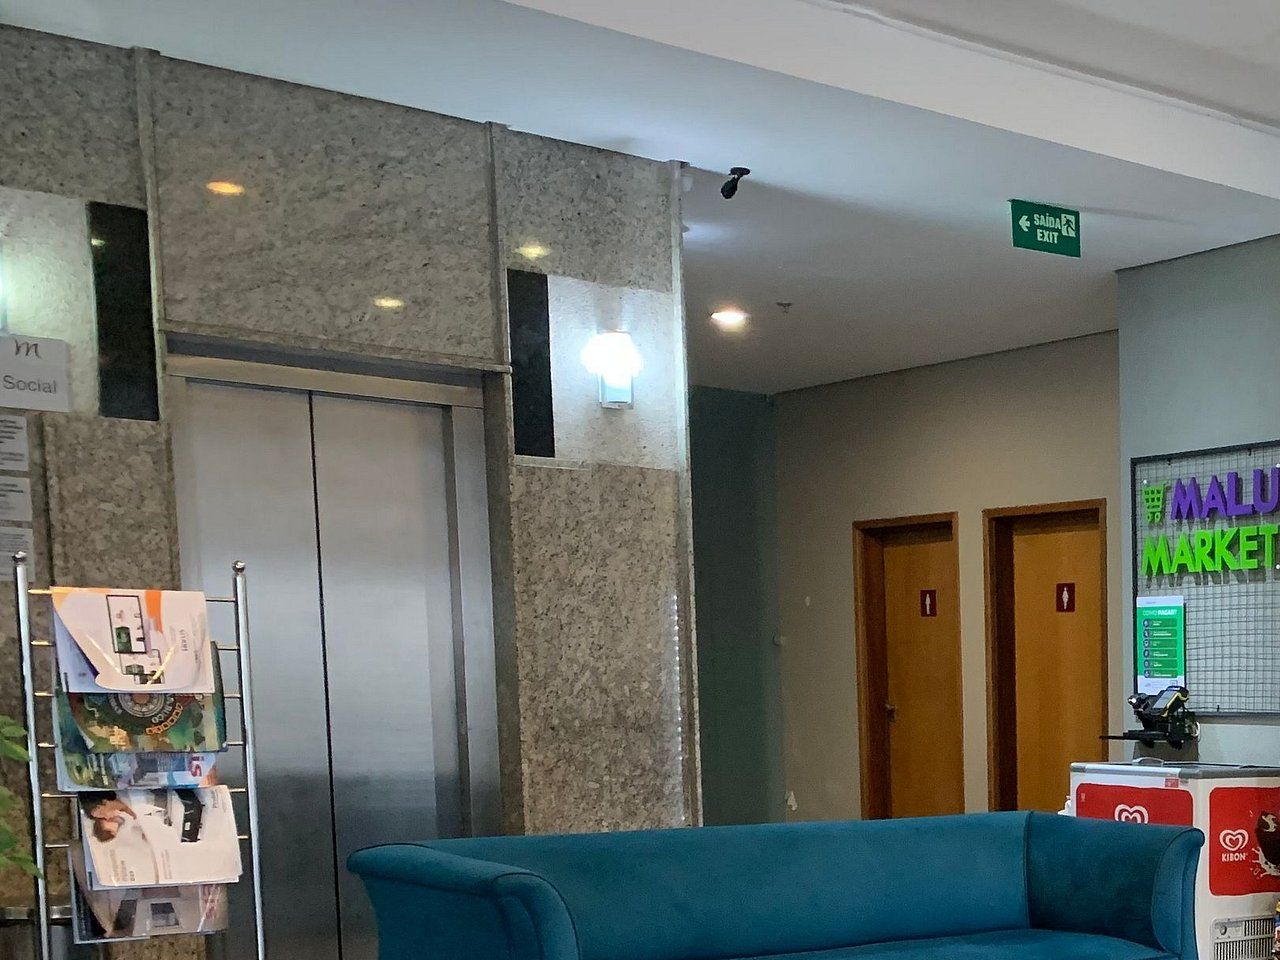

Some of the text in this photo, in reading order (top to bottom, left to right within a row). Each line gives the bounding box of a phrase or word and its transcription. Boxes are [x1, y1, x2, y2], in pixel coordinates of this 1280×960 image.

[1034, 213, 1061, 230] SAÍDA
[1037, 229, 1059, 244] EXIT
[3, 375, 57, 394] Social
[1142, 525, 1280, 575] MARKET
[1221, 853, 1246, 862] KIBON
